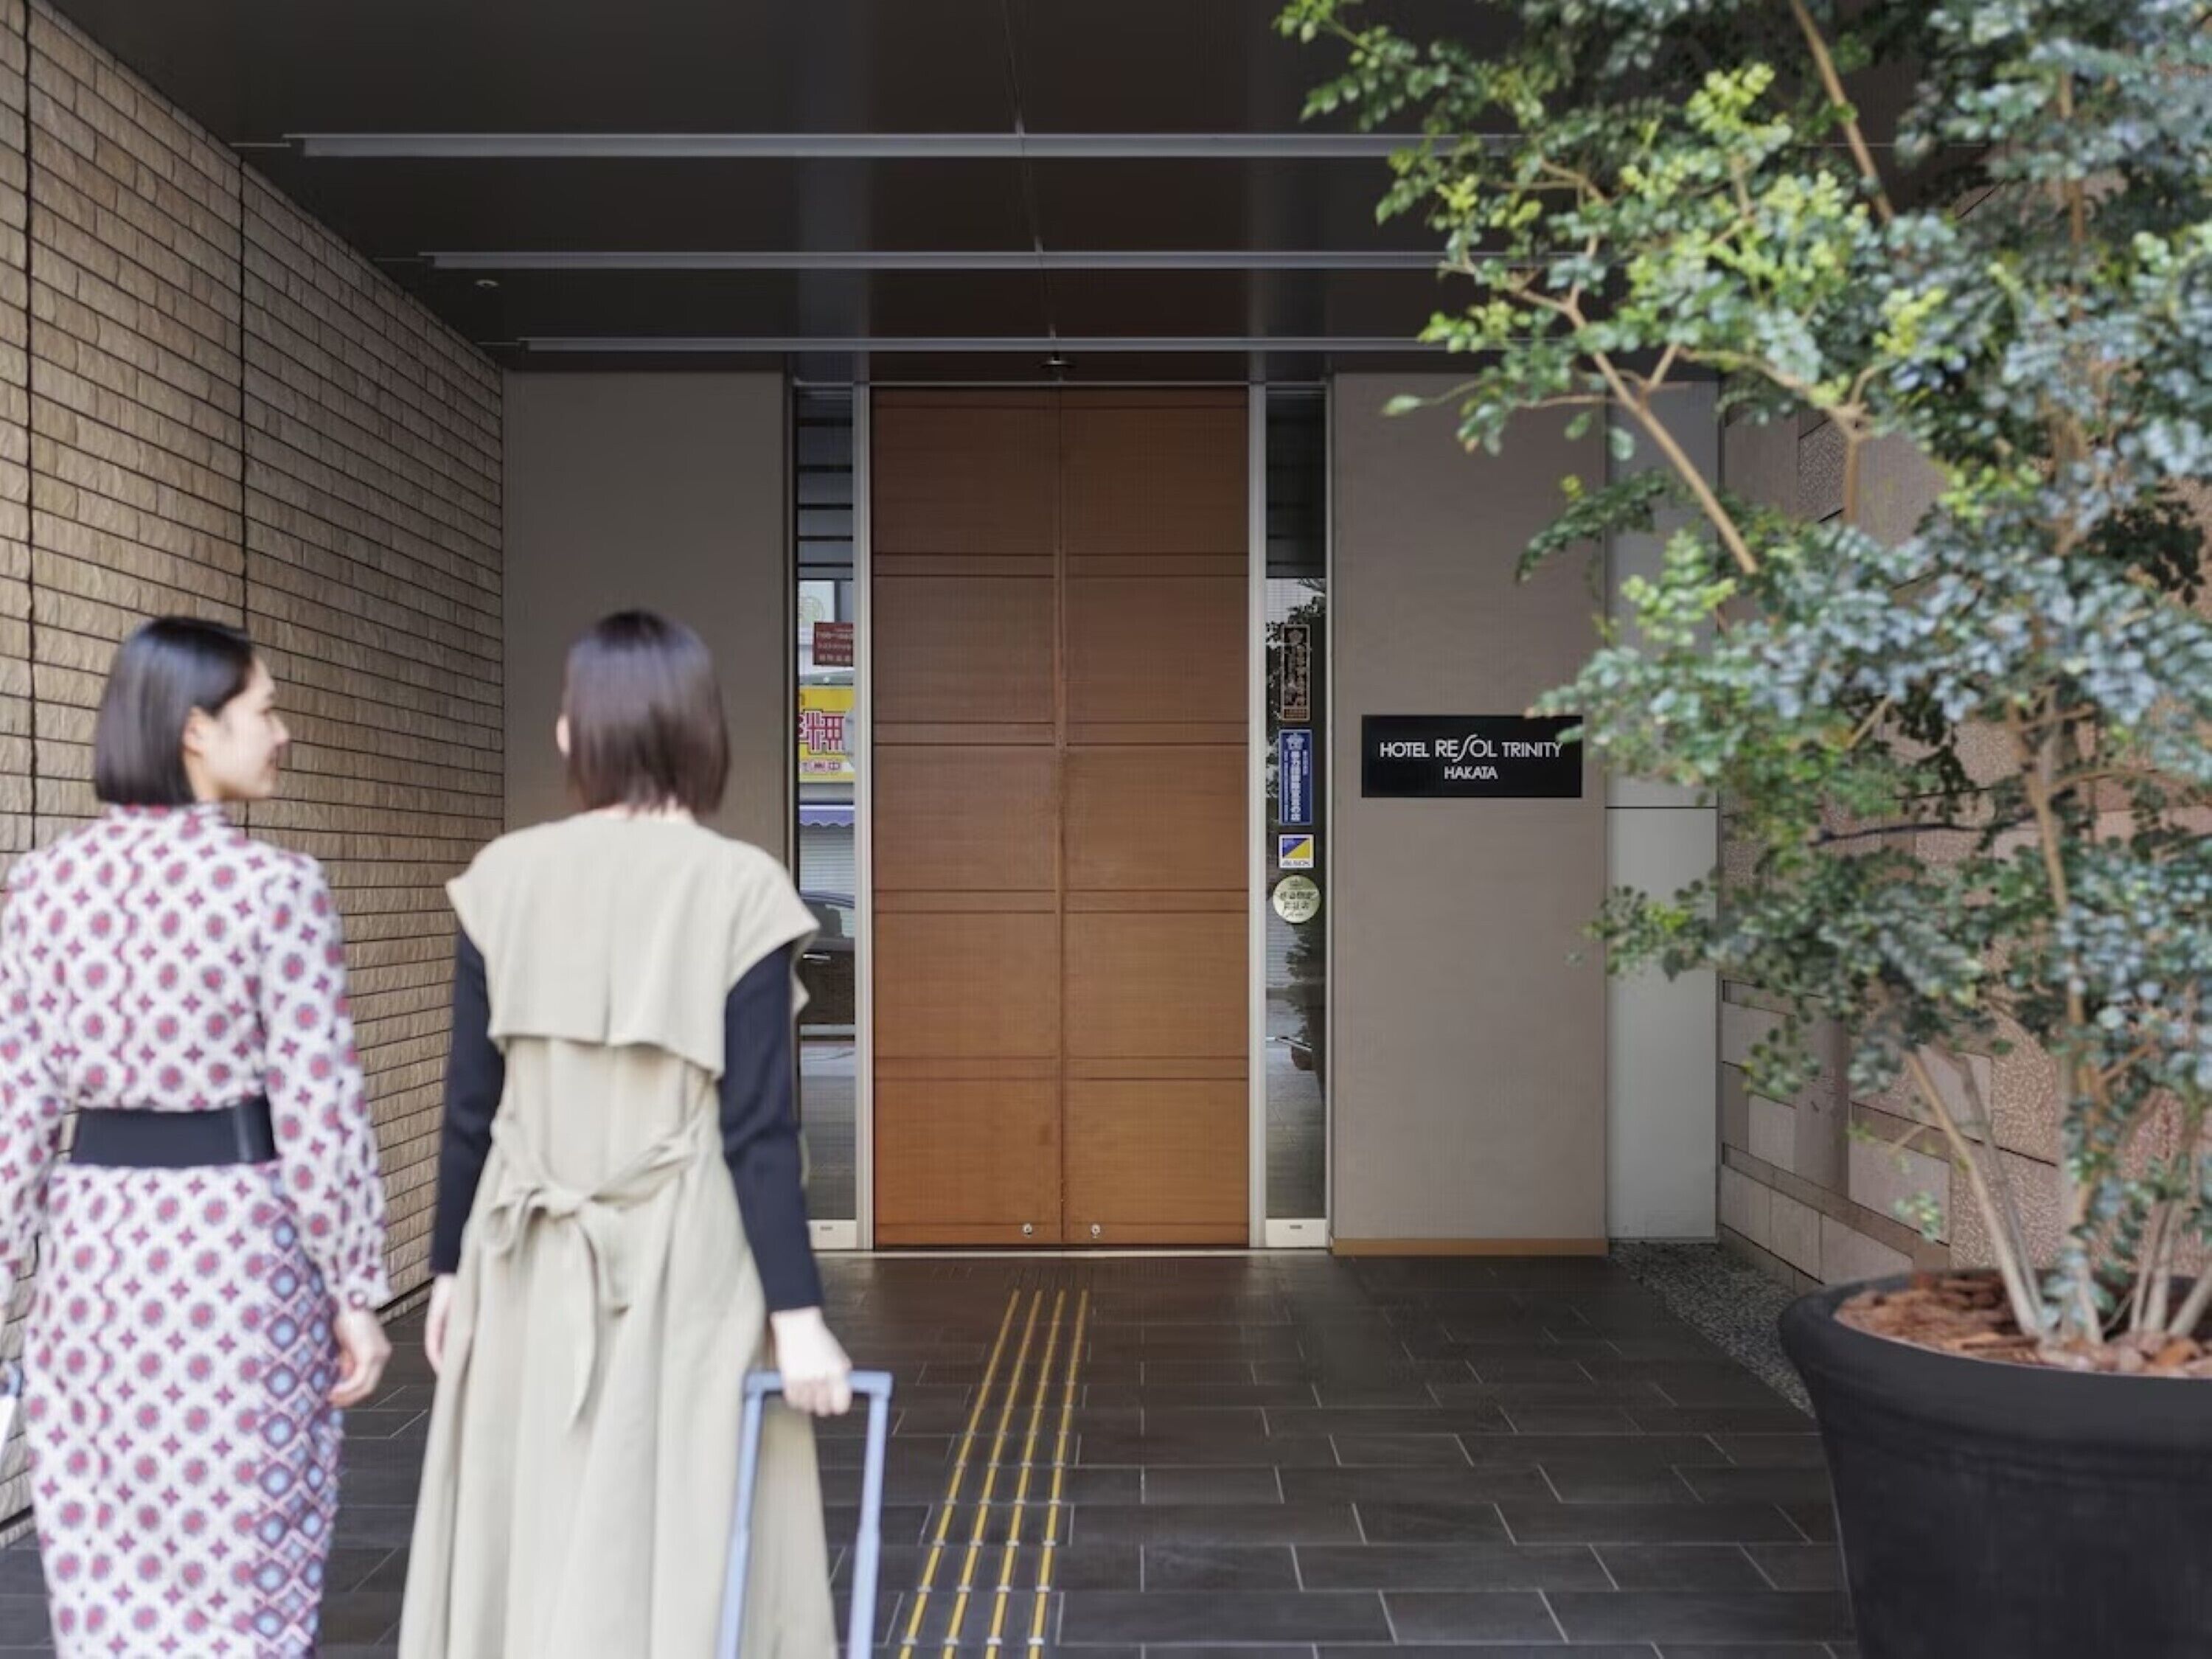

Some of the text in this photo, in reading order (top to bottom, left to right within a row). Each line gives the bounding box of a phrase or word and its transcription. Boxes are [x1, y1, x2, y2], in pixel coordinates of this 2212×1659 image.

[1380, 734, 1562, 762] HOTEL RESOL TRINITY
[1444, 766, 1498, 779] HAKATA
